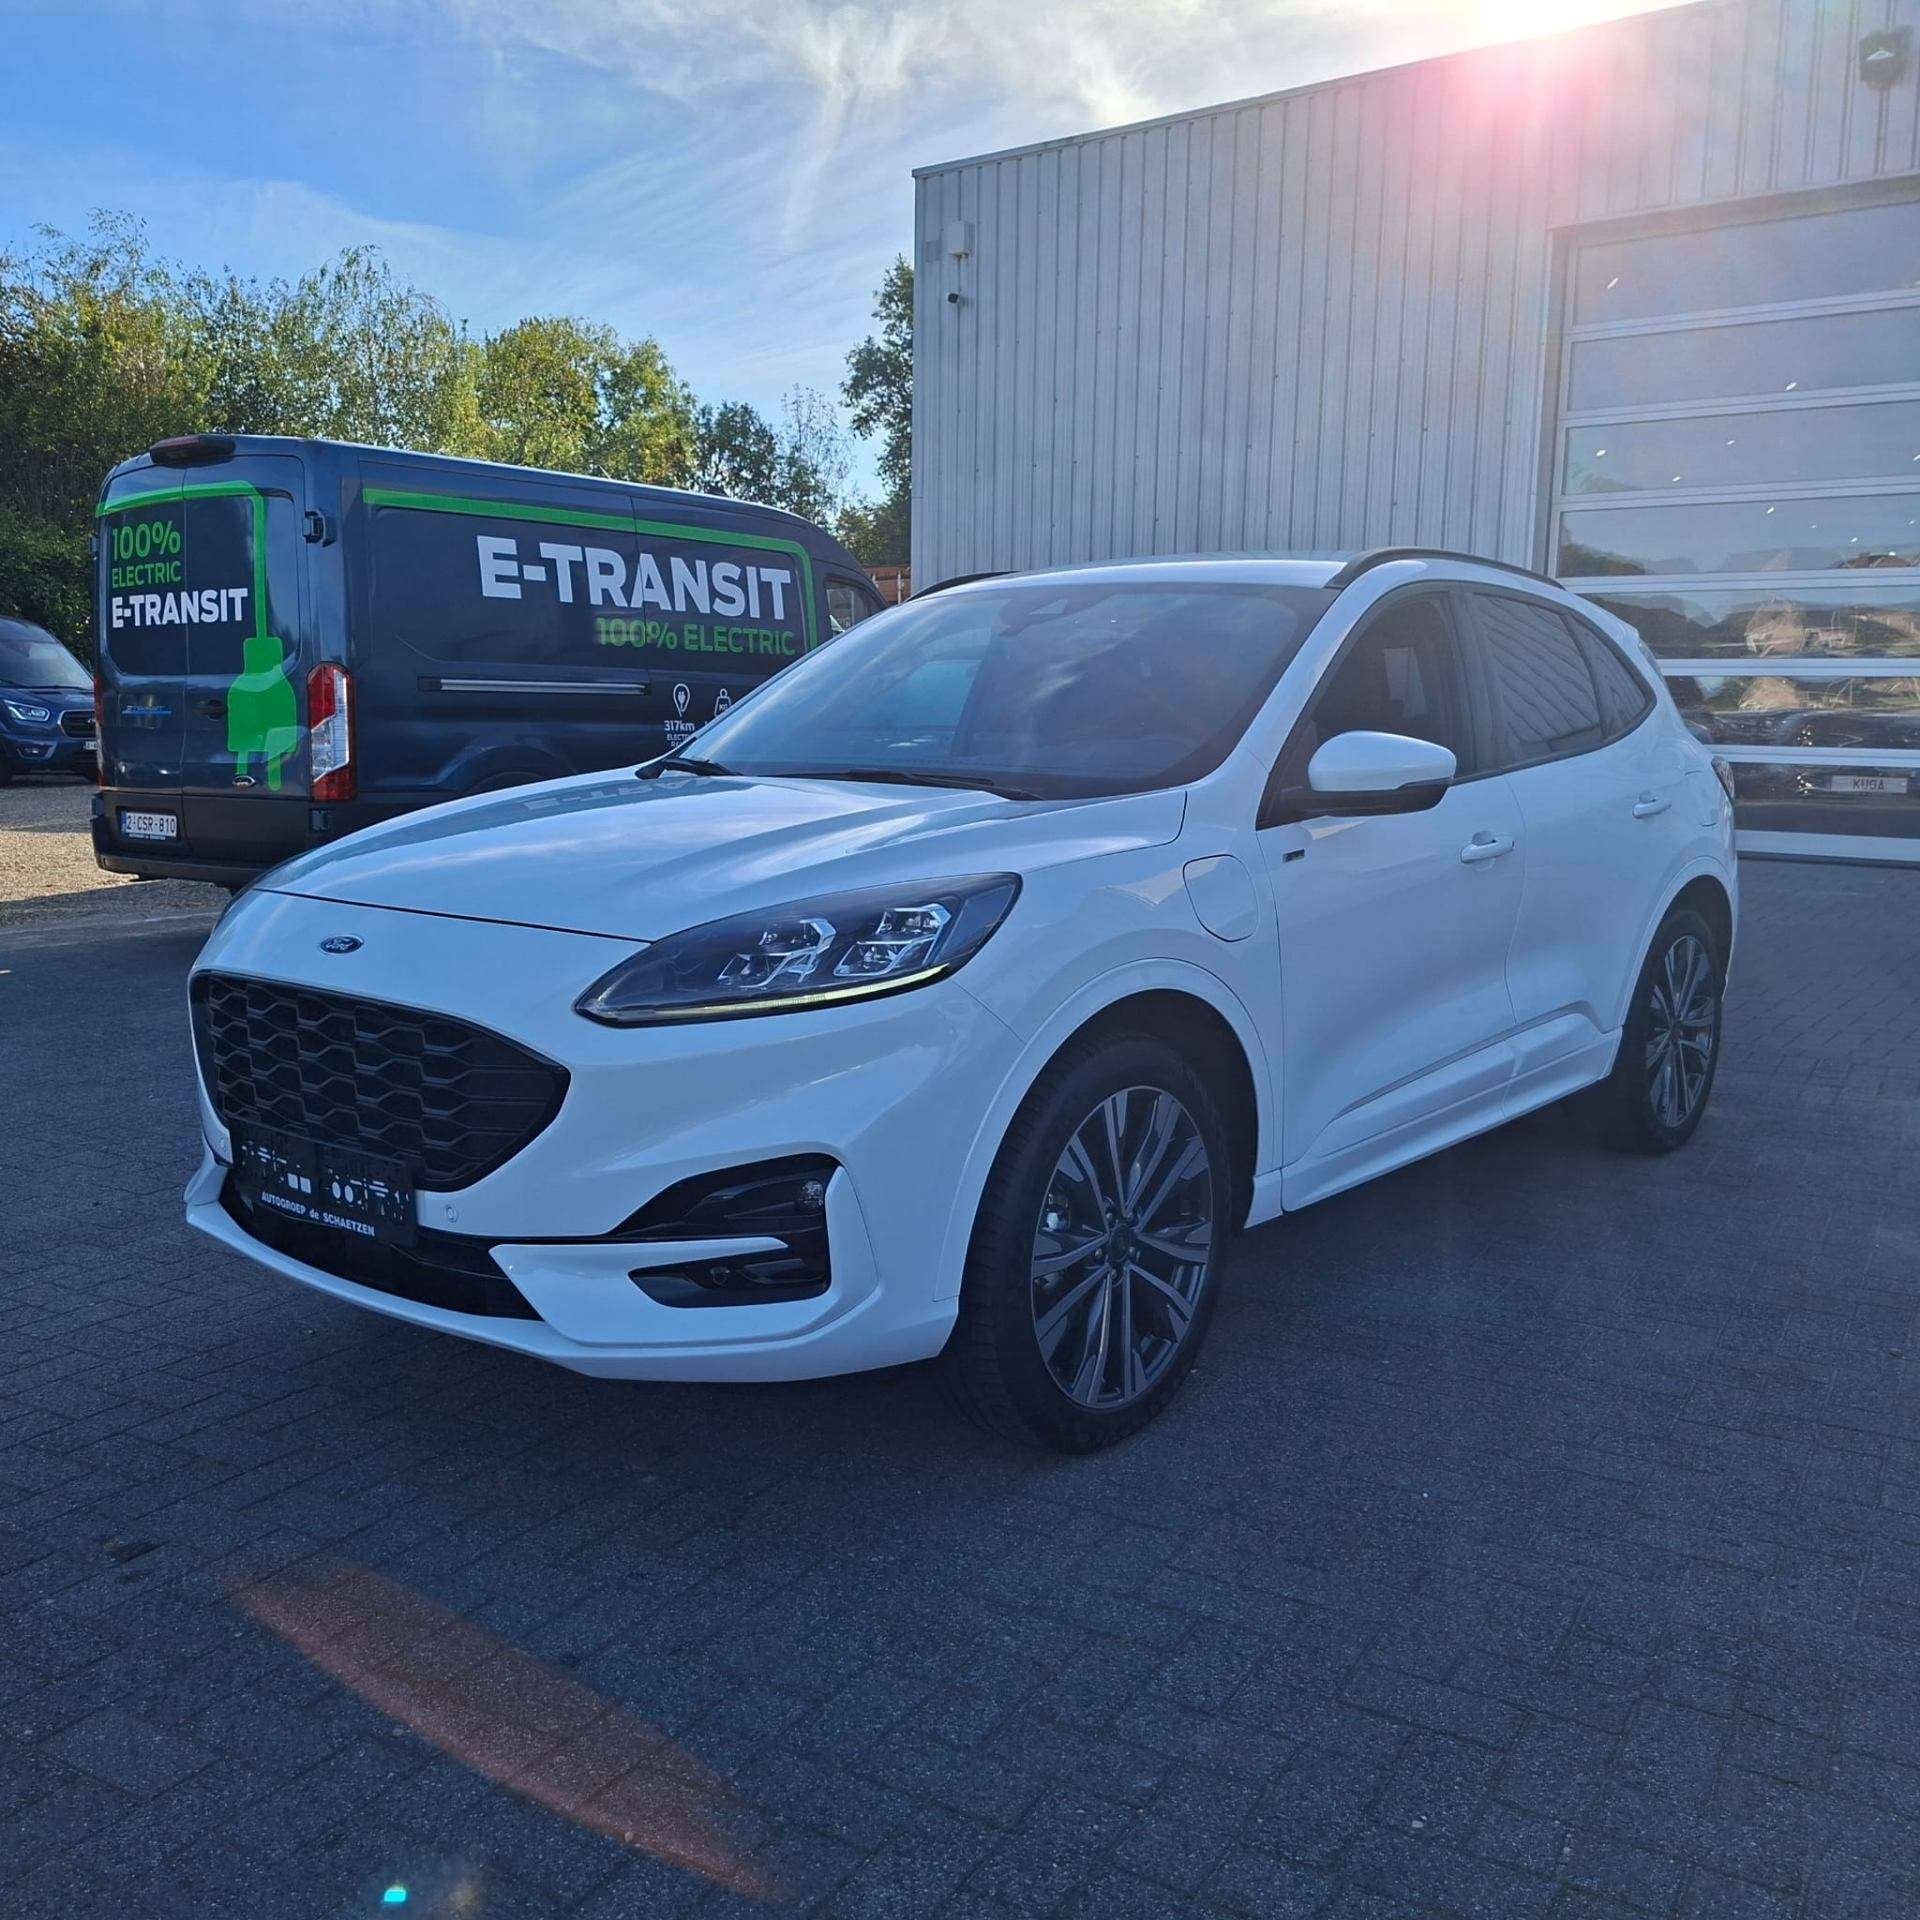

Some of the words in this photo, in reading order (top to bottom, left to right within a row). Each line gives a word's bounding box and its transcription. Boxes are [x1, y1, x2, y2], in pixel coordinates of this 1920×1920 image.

[112, 520, 181, 561] 100%
[112, 561, 181, 588] ELECTRIC
[477, 535, 791, 620] E-TRANSIT
[112, 588, 248, 628] E-TRANSIT
[596, 617, 678, 649] 100%
[684, 623, 796, 656] ELECTRIC
[664, 720, 695, 732] 317km
[126, 814, 176, 834] 2-CSR-810
[262, 1191, 306, 1215] AUTOGROEP
[309, 1209, 320, 1220] de
[323, 1212, 376, 1237] SCHAETZEN
